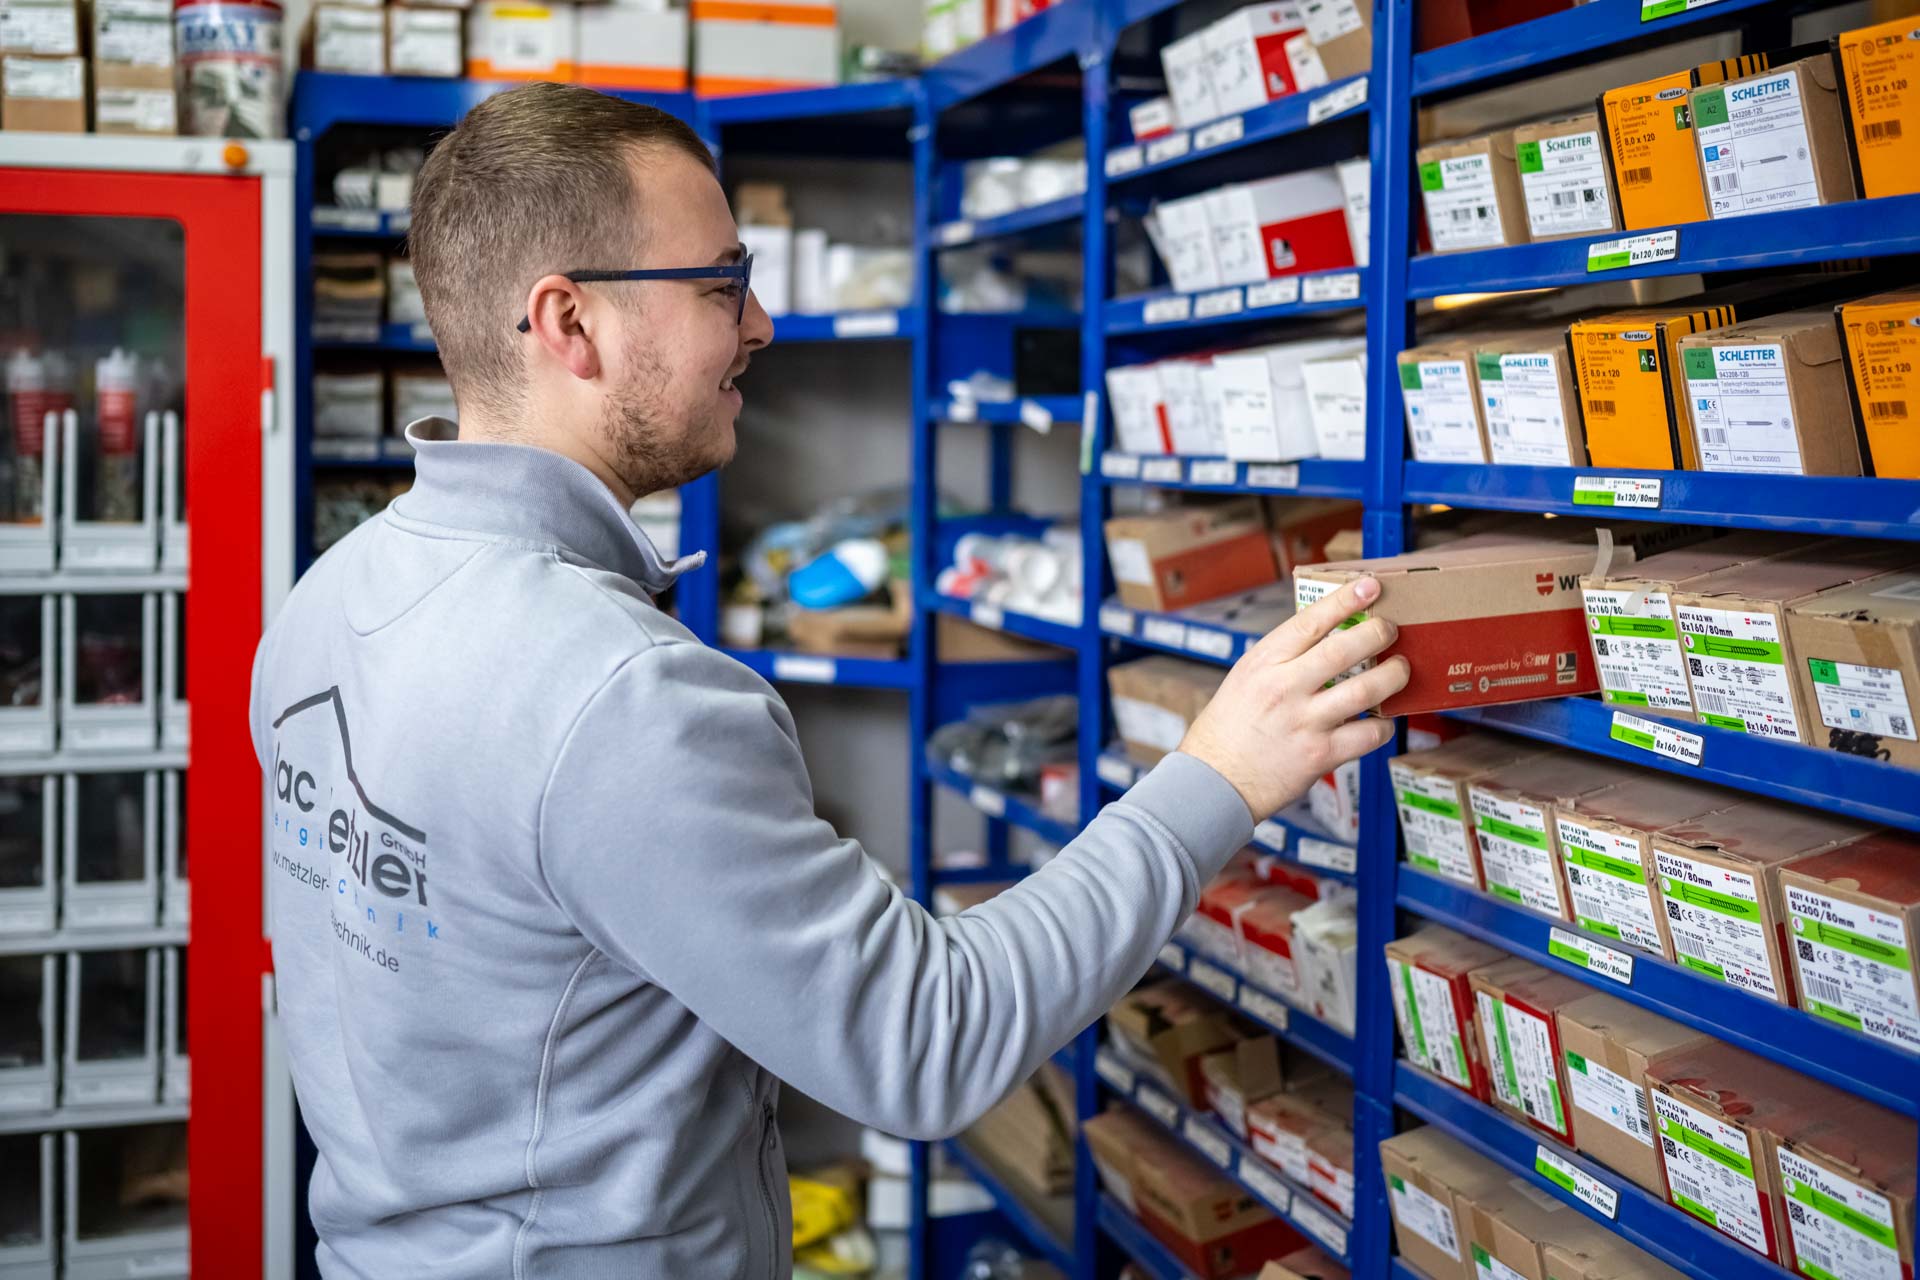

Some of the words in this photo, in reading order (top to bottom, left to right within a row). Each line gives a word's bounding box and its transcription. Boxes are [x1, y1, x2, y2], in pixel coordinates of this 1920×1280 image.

[1660, 88, 1684, 99] Eurotec
[1732, 79, 1790, 102] SCHLETTER
[1707, 106, 1716, 114] A2
[1547, 136, 1592, 152] SCHLETTER
[1643, 133, 1655, 142] 120
[1445, 160, 1483, 173] SCHLETTER
[1632, 248, 1674, 260] 8x120/80mm
[1720, 350, 1775, 361] SCHLETTER
[1424, 366, 1460, 375] SCHLETTER
[1617, 494, 1659, 503] 8x120/80mm
[1588, 605, 1623, 615] 8x160/80
[1680, 612, 1690, 621] ASSY
[1696, 614, 1703, 622] A2
[1681, 622, 1734, 637] 8x160/80mm
[1448, 663, 1472, 676] ASSY
[1474, 659, 1509, 674] powered
[1511, 658, 1520, 670] by
[1705, 665, 1715, 675] CE
[1648, 695, 1691, 706] 8x160/80mm
[1746, 721, 1797, 737] 8x160/80mm
[1656, 740, 1700, 760] 8x160/80mm
[381, 831, 426, 869] GmbH
[1562, 832, 1606, 852] 8x200/80mm
[1658, 854, 1669, 863] ASSY
[1674, 860, 1682, 868] A2
[1683, 863, 1692, 871] WH
[1582, 874, 1592, 886] CE
[1659, 864, 1712, 887] 8x200/80mm
[1789, 891, 1802, 900] ASSY
[1805, 895, 1808, 903] 4
[1811, 897, 1819, 906] A2
[1821, 900, 1831, 910] WH
[1682, 910, 1694, 922] CE
[1792, 902, 1855, 928] 8x200/80mm
[1672, 926, 1684, 934] 0181
[1817, 951, 1829, 963] CE
[1590, 958, 1630, 980] 8x200/80mm
[1802, 968, 1816, 978] 0181
[1725, 970, 1775, 994] 8x200/80mm
[1655, 1096, 1666, 1105] ASSY
[1680, 1108, 1688, 1117] WH
[1657, 1105, 1713, 1140] 8x240/100mm
[1678, 1148, 1691, 1164] CE
[1780, 1153, 1792, 1164] ASSY
[1808, 1167, 1819, 1177] WH
[1781, 1162, 1847, 1203] 8x240/100mm
[1575, 1182, 1612, 1212] 8x240/100mm
[1807, 1214, 1821, 1231] CE
[1719, 1218, 1757, 1244] 8x240/100mm
